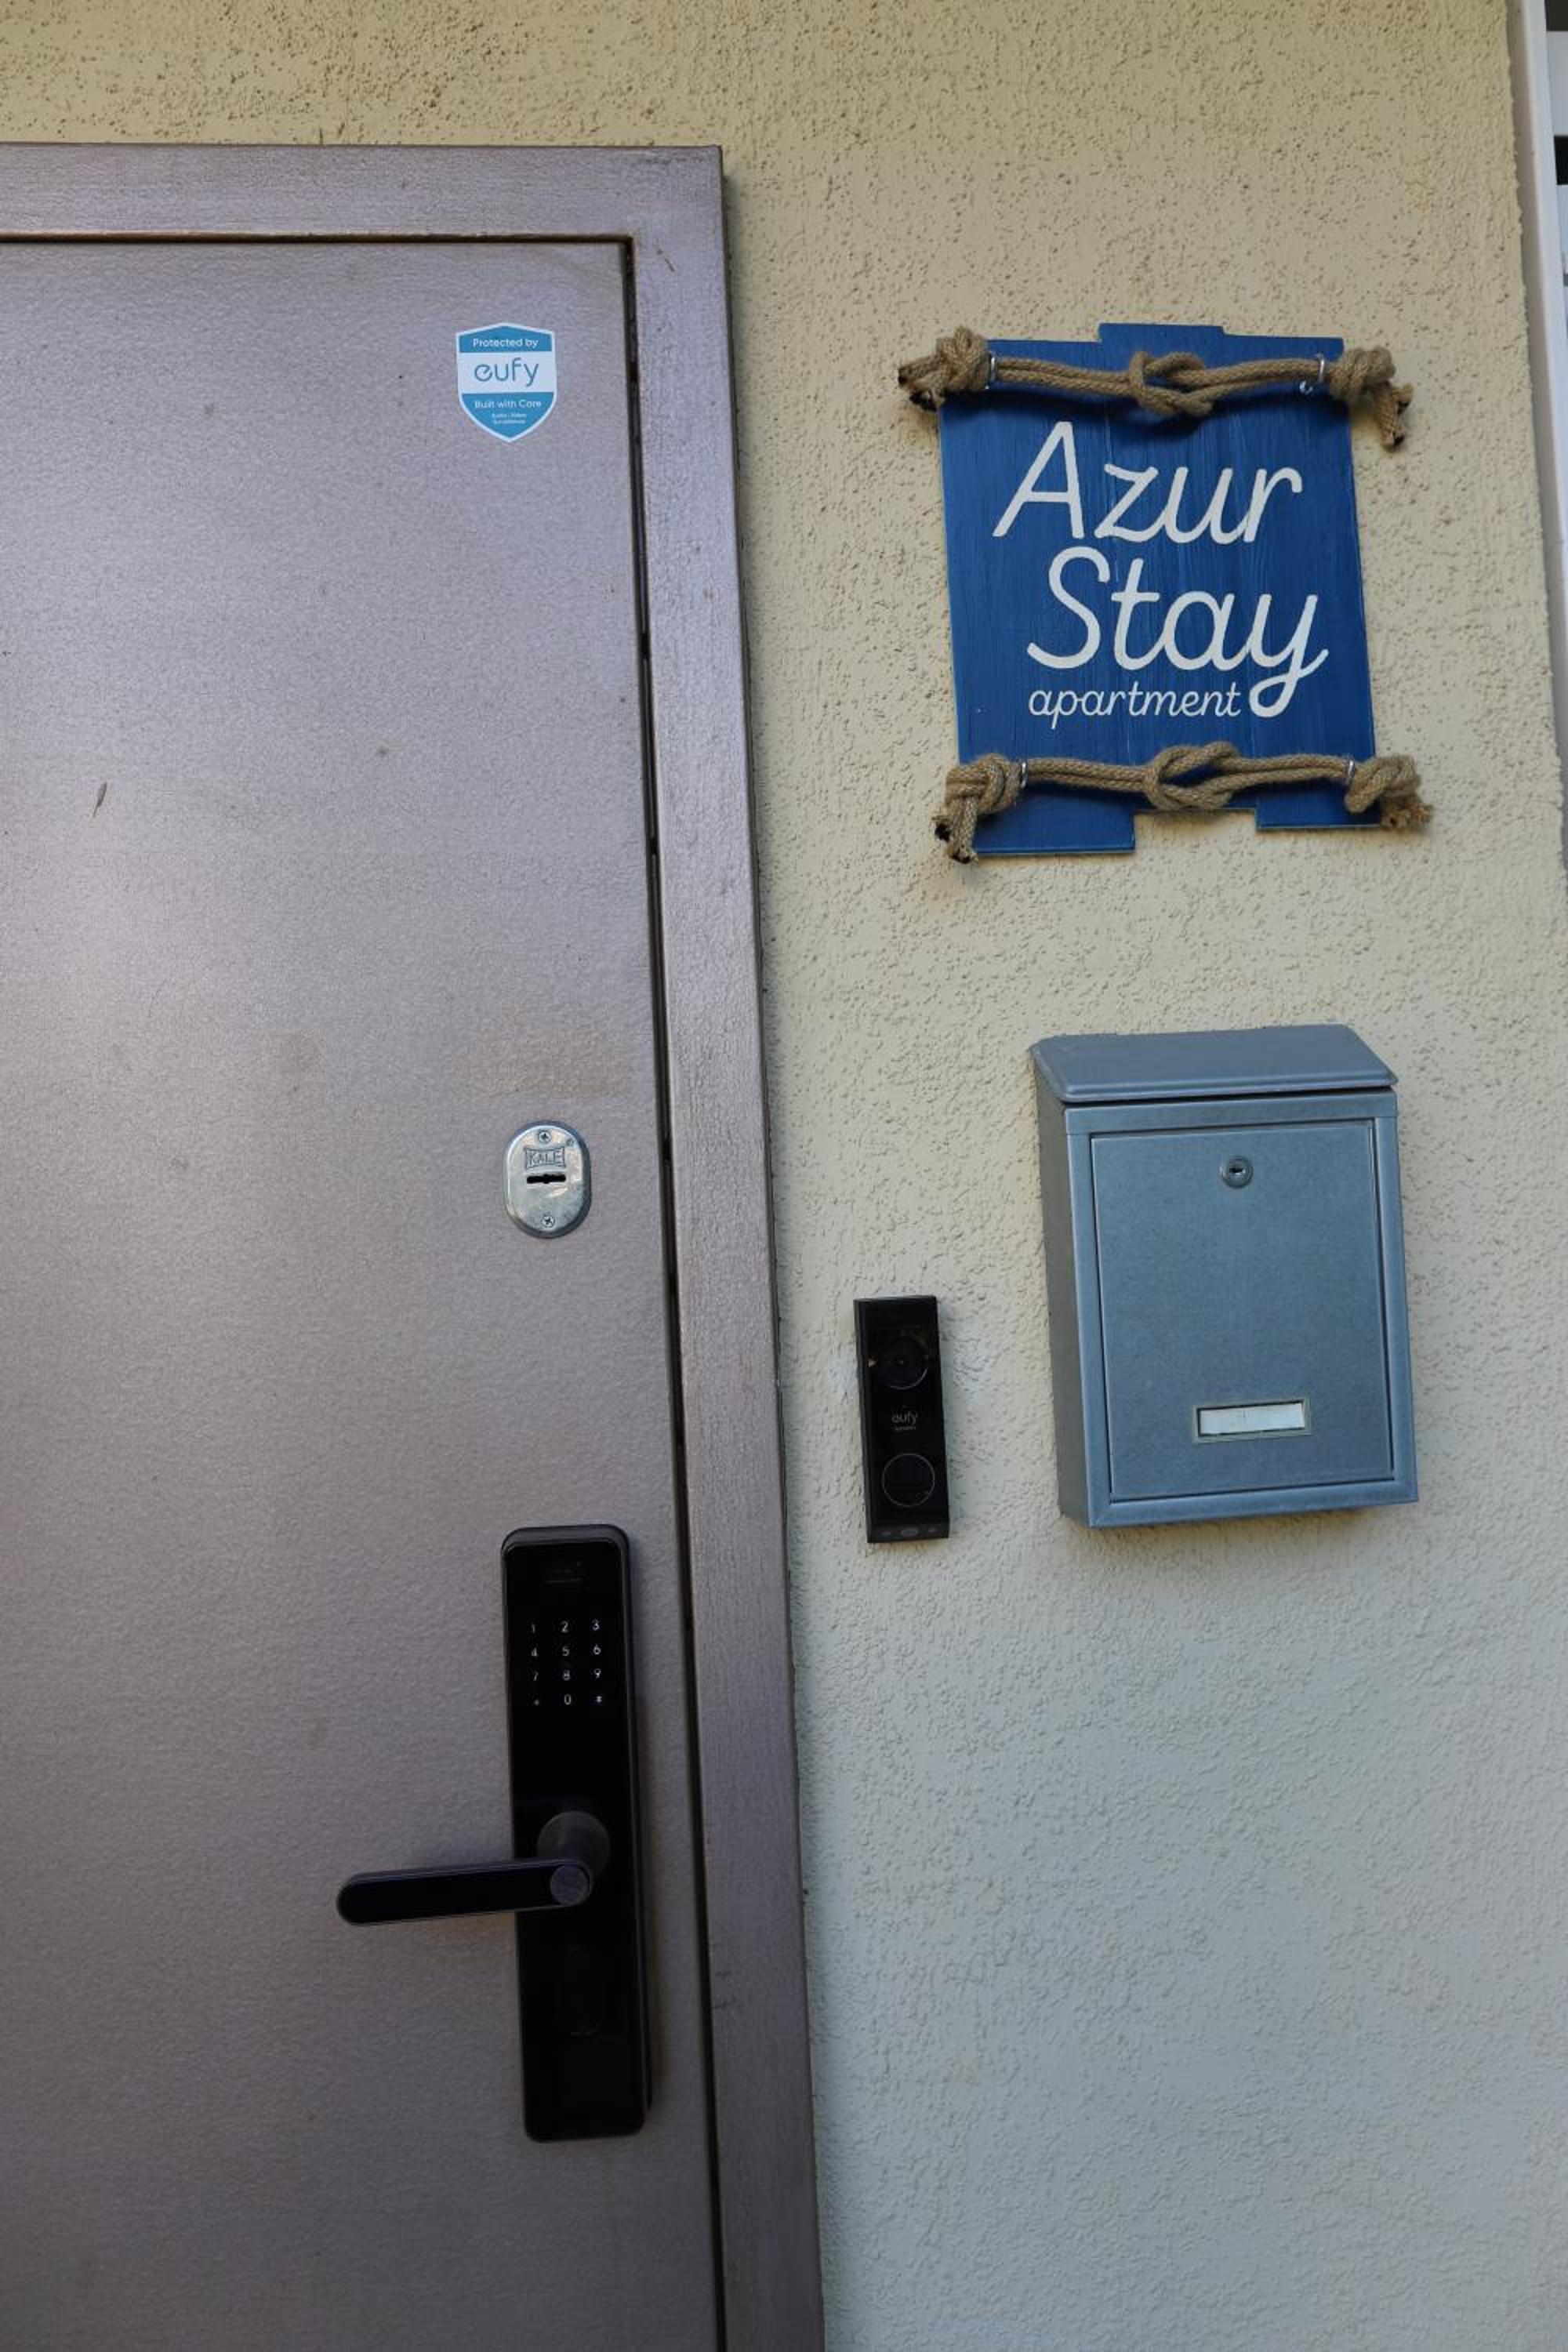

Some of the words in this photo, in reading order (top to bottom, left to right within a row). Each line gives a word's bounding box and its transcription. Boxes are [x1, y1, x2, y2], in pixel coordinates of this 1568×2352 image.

[473, 338, 523, 347] Protected
[524, 338, 539, 348] by
[474, 357, 539, 387] eufy
[496, 399, 517, 408] with
[992, 420, 1302, 544] Azur
[1026, 546, 1329, 717] Stay
[1028, 681, 1241, 730] apartment
[528, 1150, 563, 1166] KALE
[530, 1622, 536, 1633] 1
[561, 1621, 569, 1633] 2
[592, 1619, 600, 1631] 3
[531, 1647, 538, 1657] 4
[562, 1646, 570, 1657] 5
[593, 1645, 601, 1655] 6
[562, 1669, 571, 1681] 8
[593, 1668, 601, 1679] 9
[564, 1693, 572, 1705] 0
